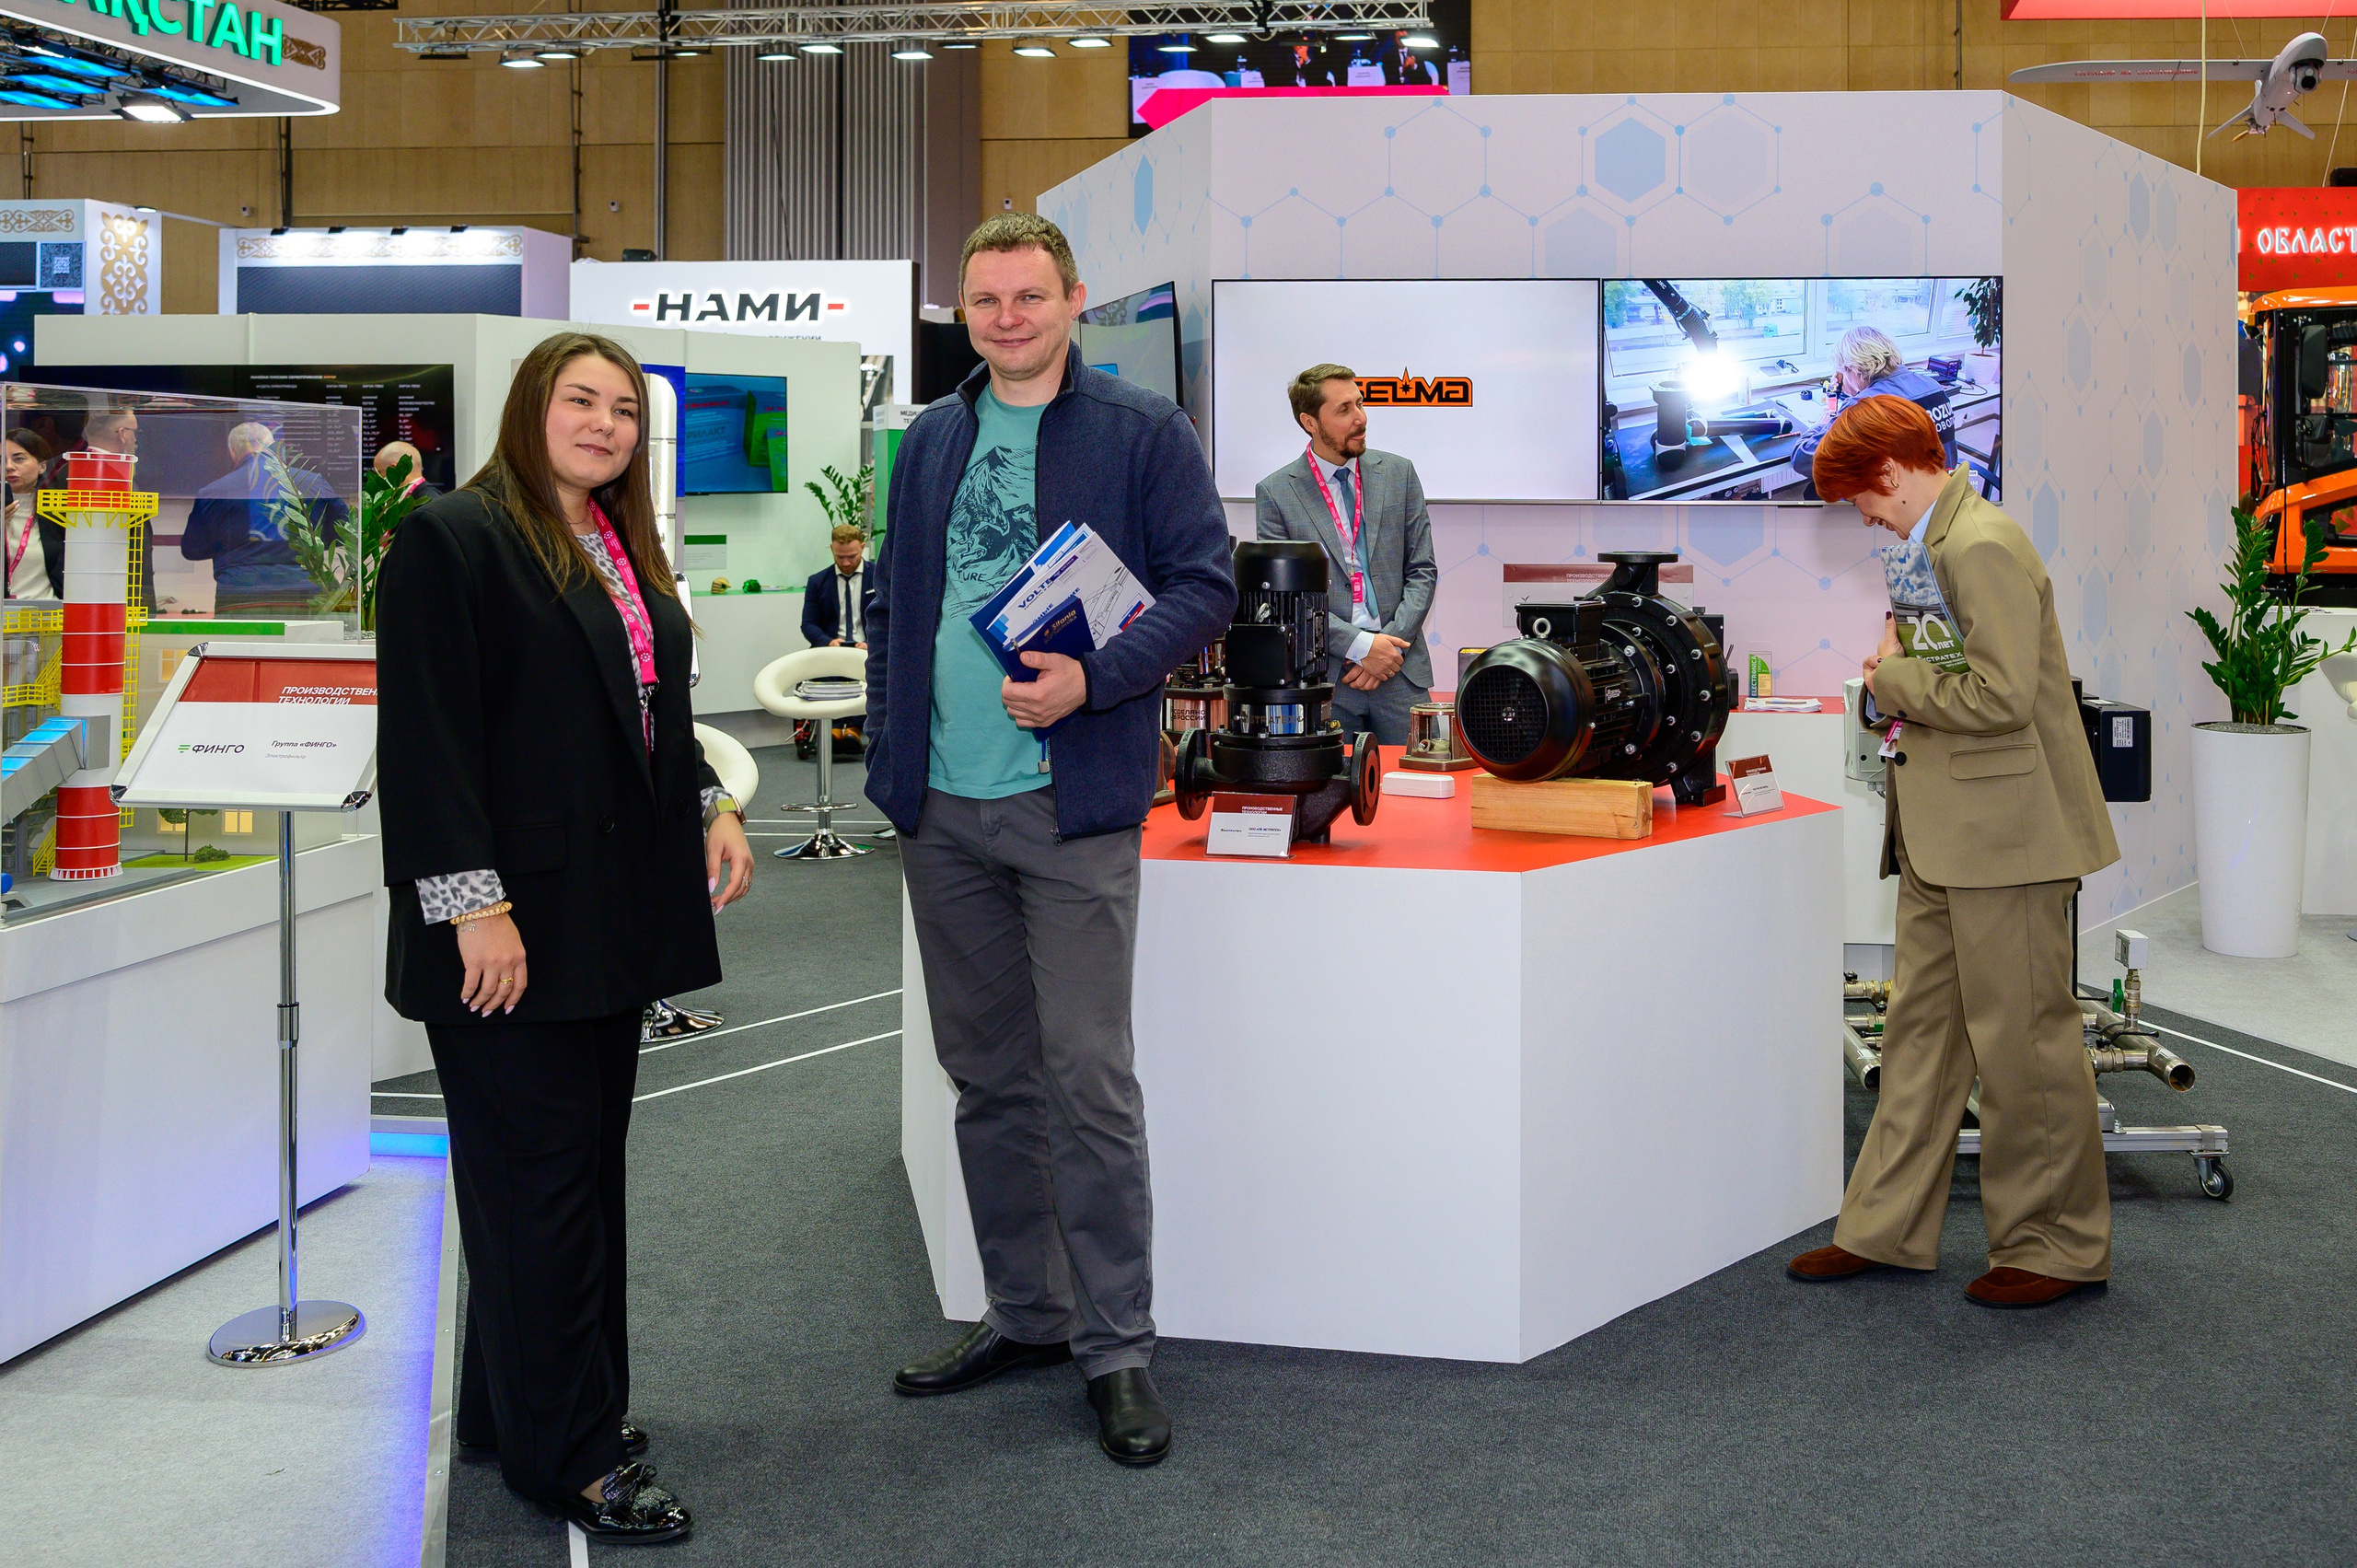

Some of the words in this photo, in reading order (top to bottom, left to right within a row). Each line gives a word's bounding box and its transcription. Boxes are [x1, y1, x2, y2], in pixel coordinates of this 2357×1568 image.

[656, 293, 821, 321] НАМИ
[1907, 614, 1951, 650] 20
[281, 686, 378, 697] ПРОИЗВОДСТВЕН
[278, 696, 352, 705] ТЕХНОЛОГИИ
[192, 744, 245, 754] ФИНГО
